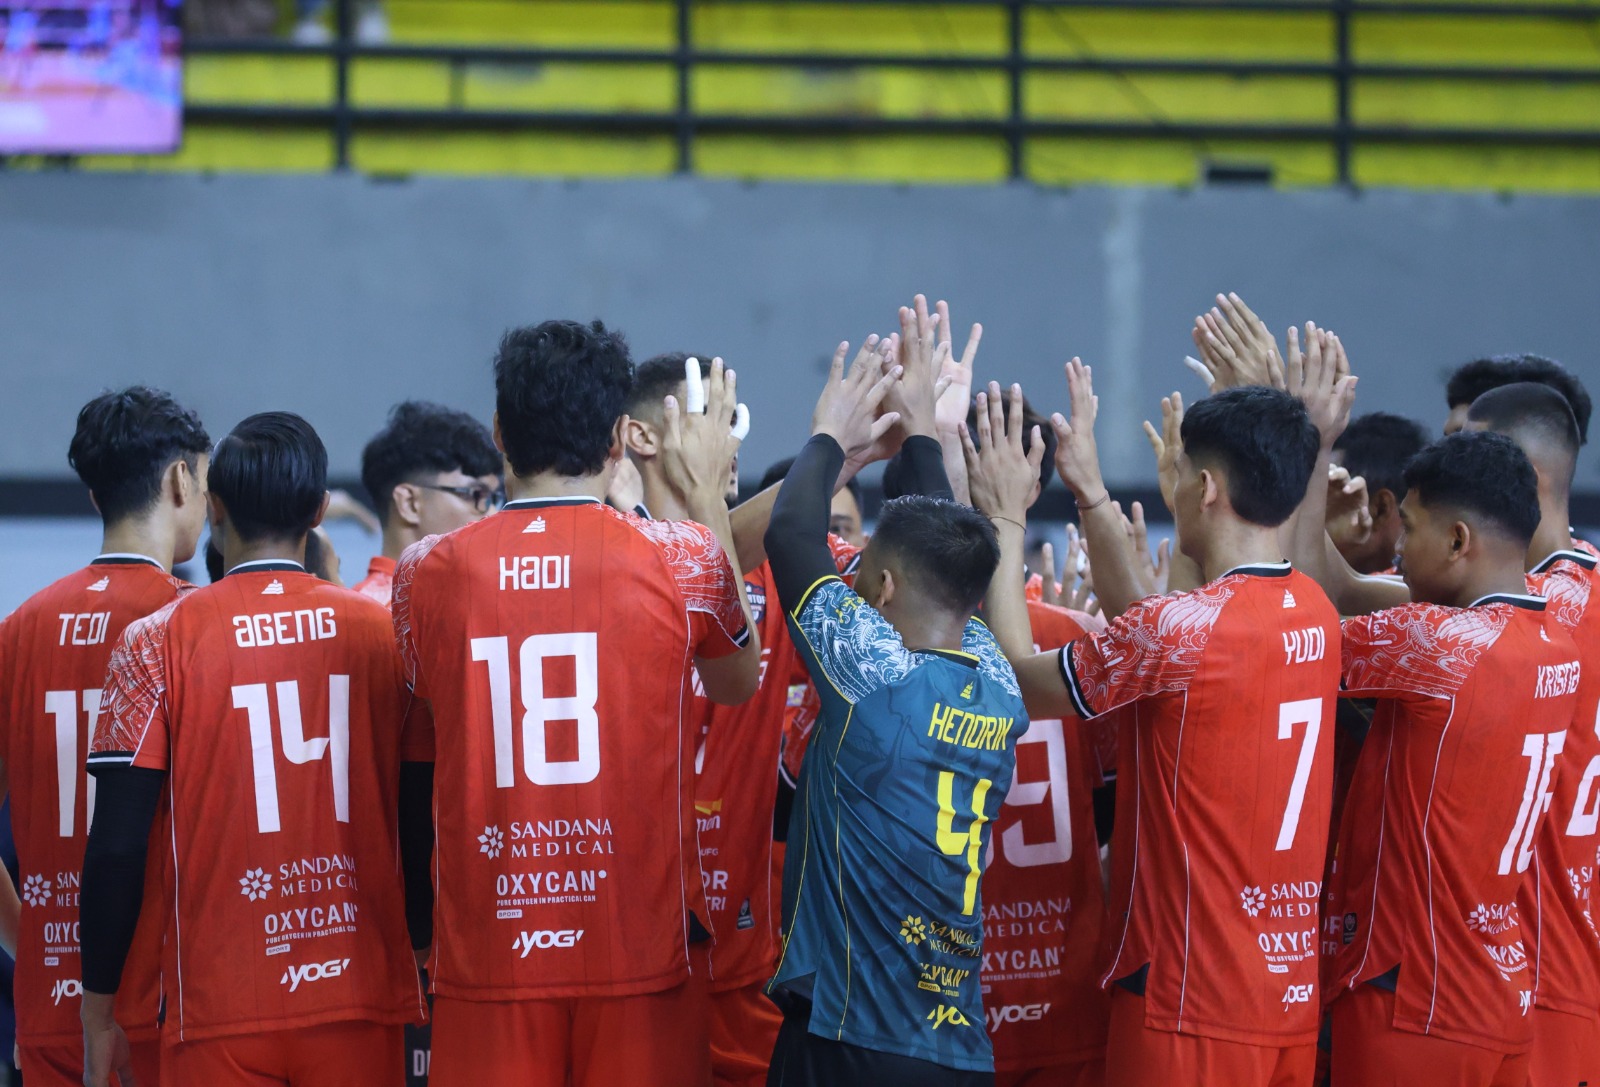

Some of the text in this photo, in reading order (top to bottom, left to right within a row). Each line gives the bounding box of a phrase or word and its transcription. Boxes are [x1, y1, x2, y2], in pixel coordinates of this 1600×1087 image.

[59, 611, 111, 646] TEDI
[1282, 626, 1326, 666] YUDI
[470, 632, 601, 789] 18
[927, 702, 1014, 751] HENDRIK
[231, 674, 351, 834] 14
[1274, 697, 1323, 851] 7
[984, 718, 1073, 868] 9
[510, 818, 613, 840] SANDANA
[934, 771, 992, 916] 4
[280, 854, 356, 881] SANDANA
[511, 840, 615, 858] MEDICAL
[281, 874, 358, 898] MEDICAL
[496, 869, 596, 896] OXYCAN
[264, 901, 356, 935] OXYCAN
